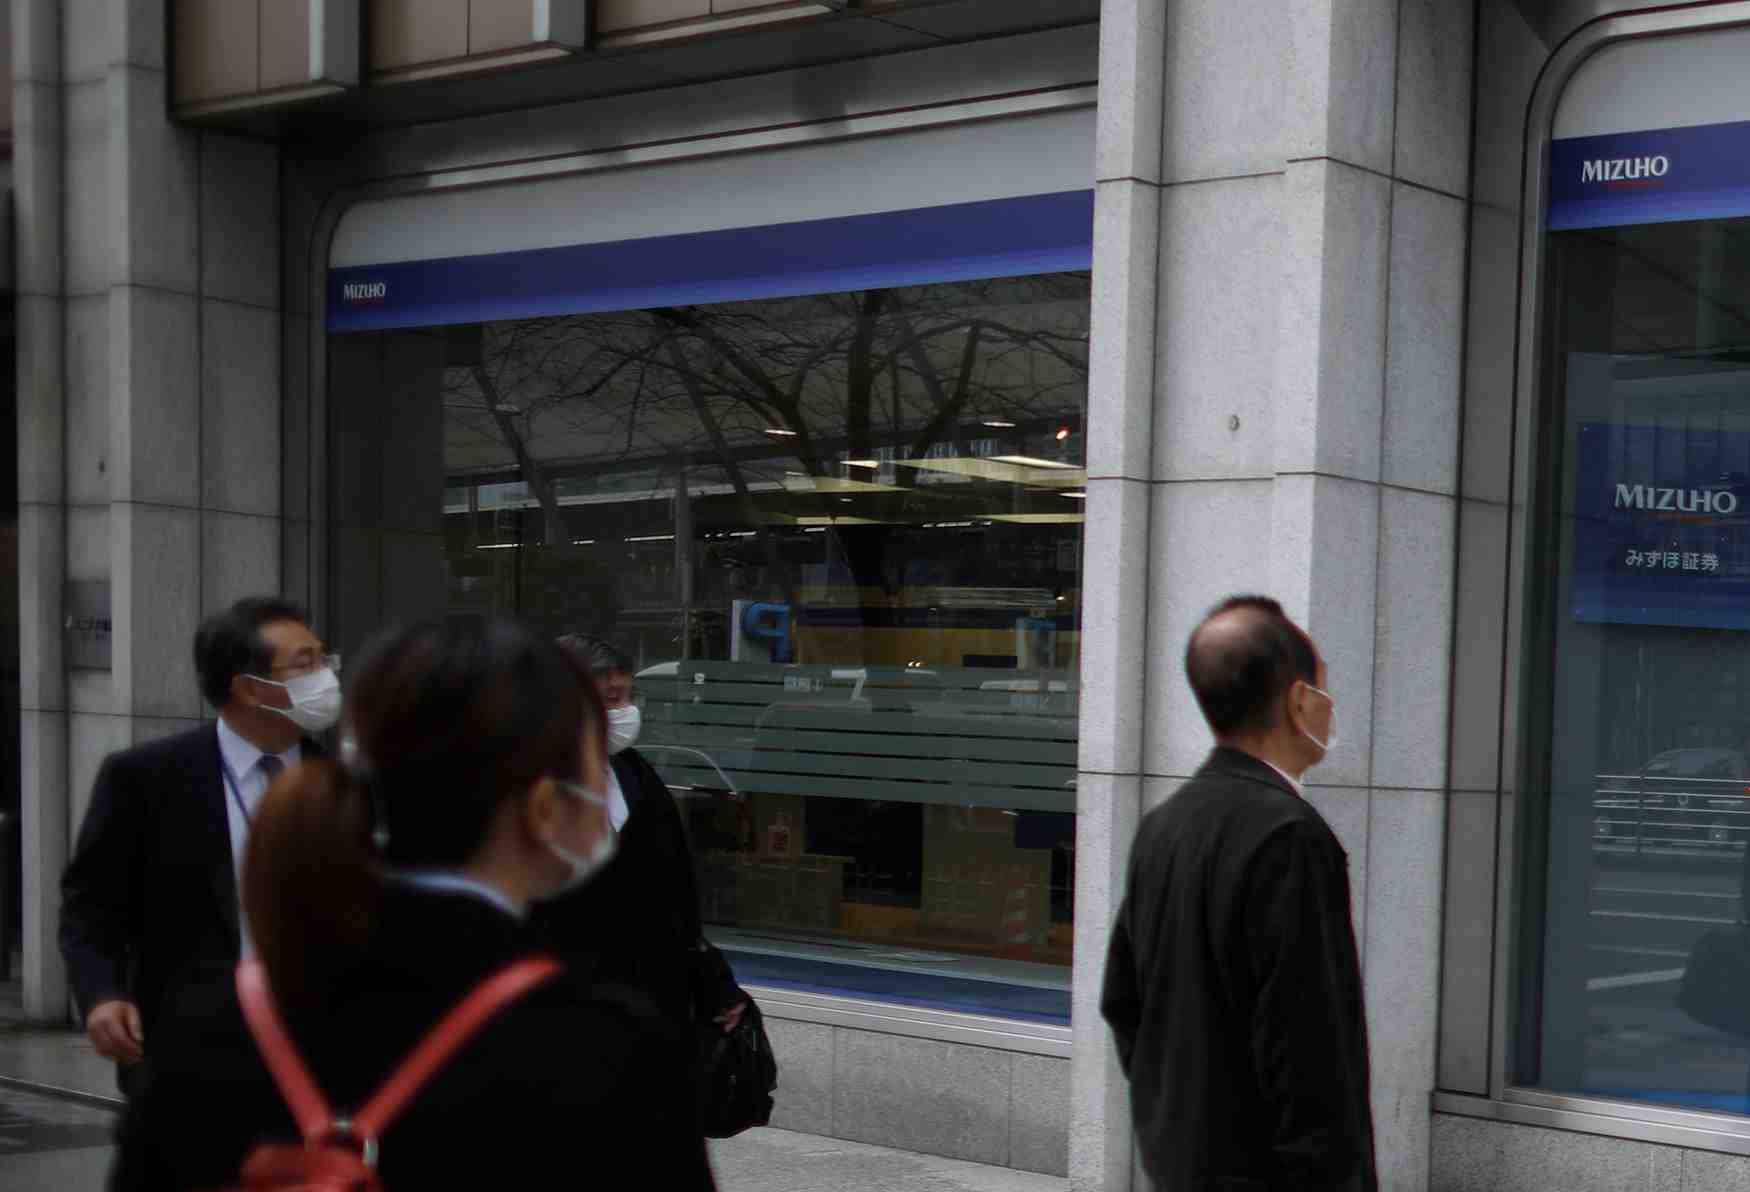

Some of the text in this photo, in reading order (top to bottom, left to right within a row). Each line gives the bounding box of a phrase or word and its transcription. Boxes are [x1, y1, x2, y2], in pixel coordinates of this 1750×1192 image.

[1581, 154, 1669, 185] MIZUHO
[343, 281, 386, 301] MIZUHO
[1614, 482, 1738, 515] MIZUHO
[1624, 548, 1720, 573] みずほ証券
